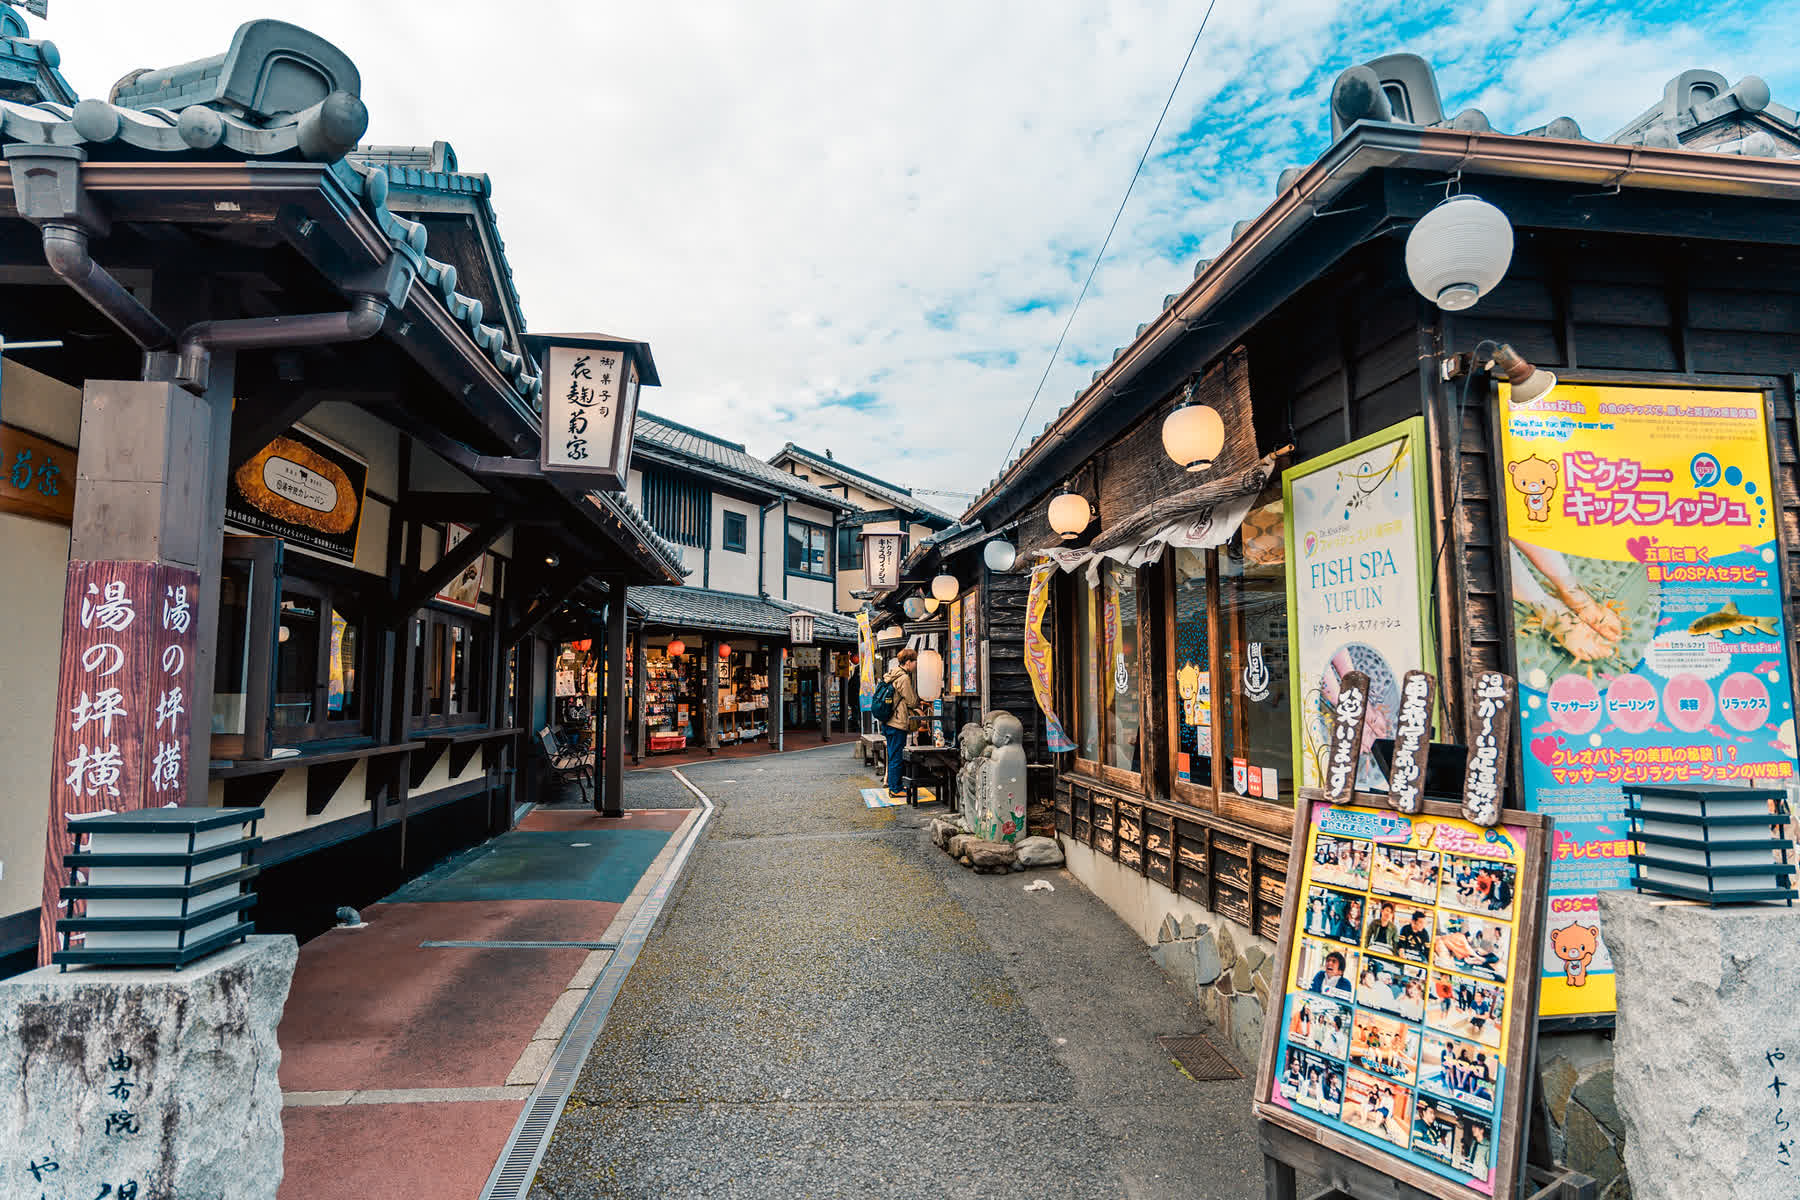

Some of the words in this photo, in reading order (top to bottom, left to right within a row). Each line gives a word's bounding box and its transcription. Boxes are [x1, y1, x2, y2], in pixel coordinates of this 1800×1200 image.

[0, 447, 61, 497] 菊家
[1566, 490, 1750, 524] キッスフィッシュ
[1311, 556, 1353, 590] FISH
[1359, 547, 1398, 580] SPA
[1323, 584, 1383, 614] YUFUIN
[151, 585, 191, 808] 湯の坪横
[1550, 700, 1600, 712] マッサージ
[1609, 699, 1656, 711] ピーリング
[1679, 699, 1699, 711] 美容
[1722, 697, 1768, 709] リラックス
[1553, 898, 1598, 912] ドクター
[105, 1049, 139, 1135] 由布院
[1765, 1048, 1795, 1166] やすらぎ
[27, 1156, 60, 1200] や
